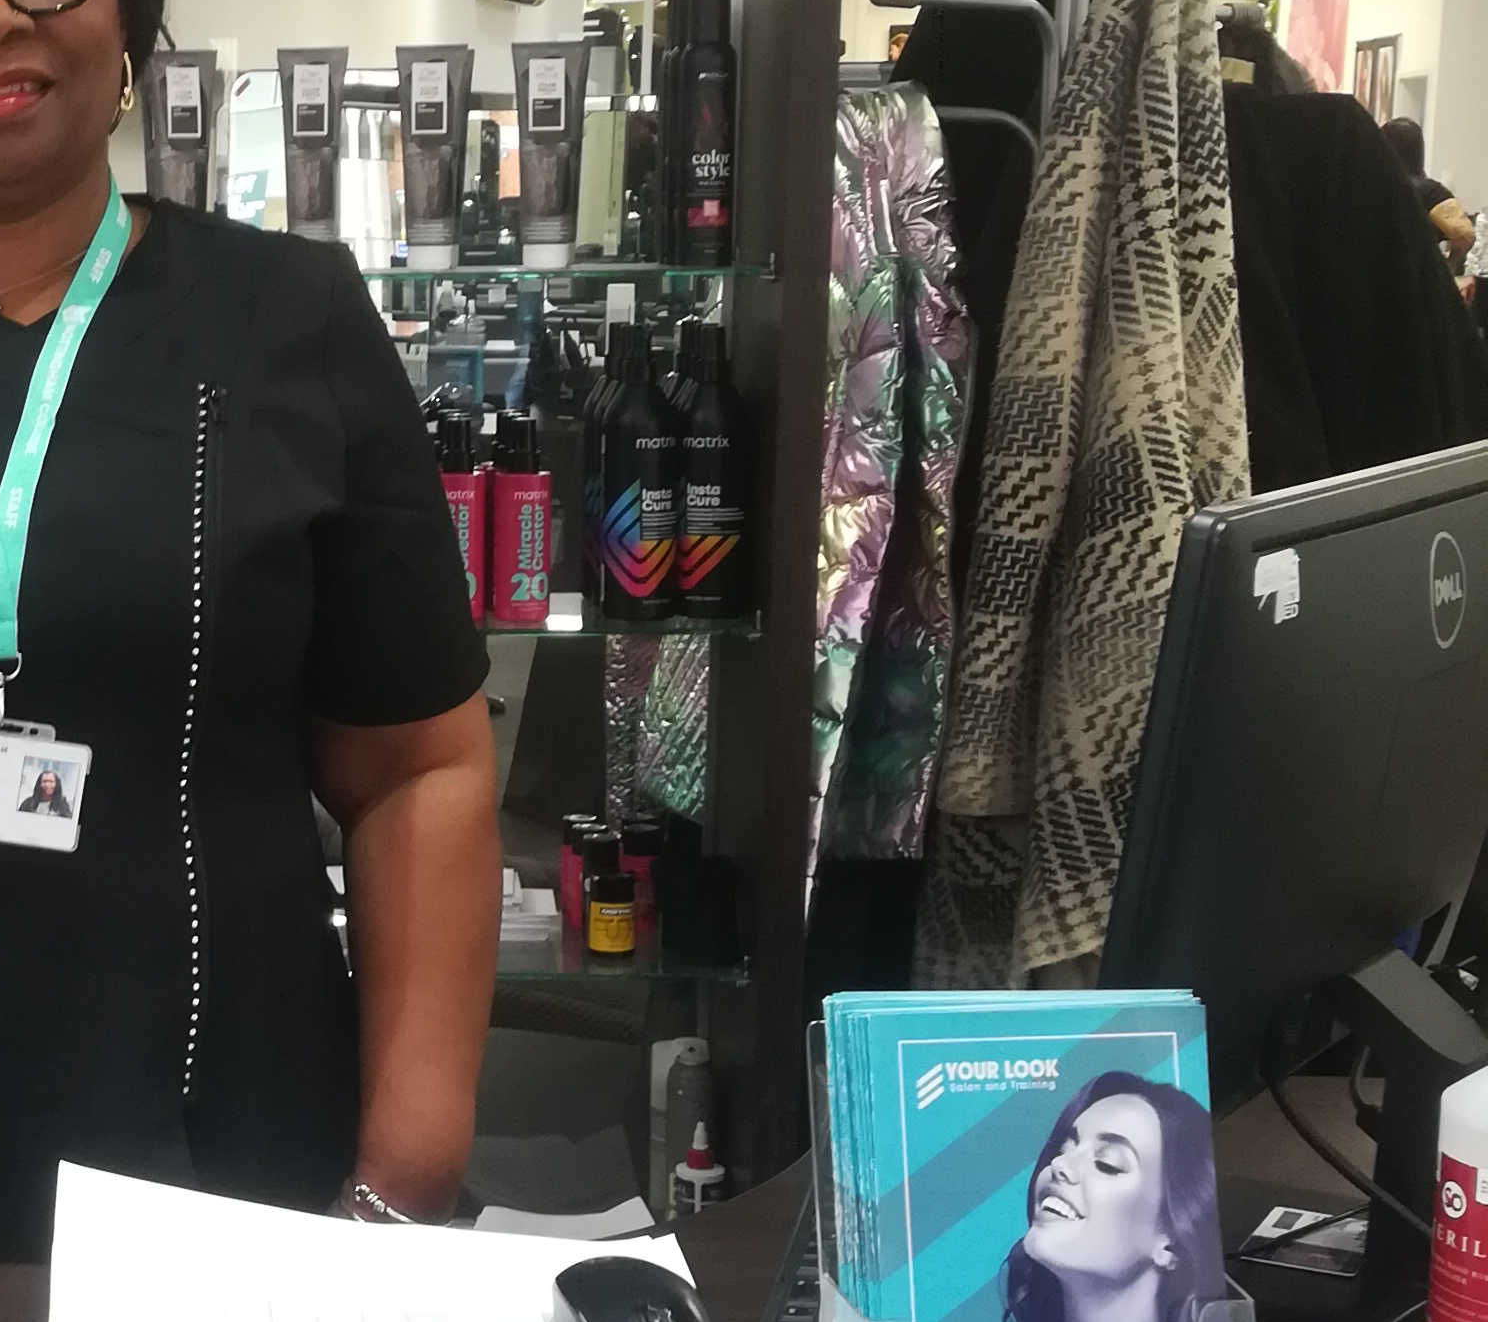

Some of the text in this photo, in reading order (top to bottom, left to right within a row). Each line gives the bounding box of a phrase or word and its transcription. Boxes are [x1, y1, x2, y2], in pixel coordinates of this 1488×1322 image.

[691, 149, 731, 165] color
[694, 163, 731, 181] style
[635, 436, 676, 450] matri
[682, 434, 730, 449] matrix
[513, 489, 548, 501] matrix
[686, 482, 721, 496] Insta
[686, 494, 721, 507] Cure
[517, 503, 533, 570] Miracle
[532, 502, 544, 571] Creator
[510, 571, 549, 601] 20
[1434, 571, 1464, 607] DELL
[945, 1058, 1060, 1081] YOUR LOOK
[949, 1079, 1057, 1093] Salon and Training
[1434, 1220, 1487, 1259] ERIL
